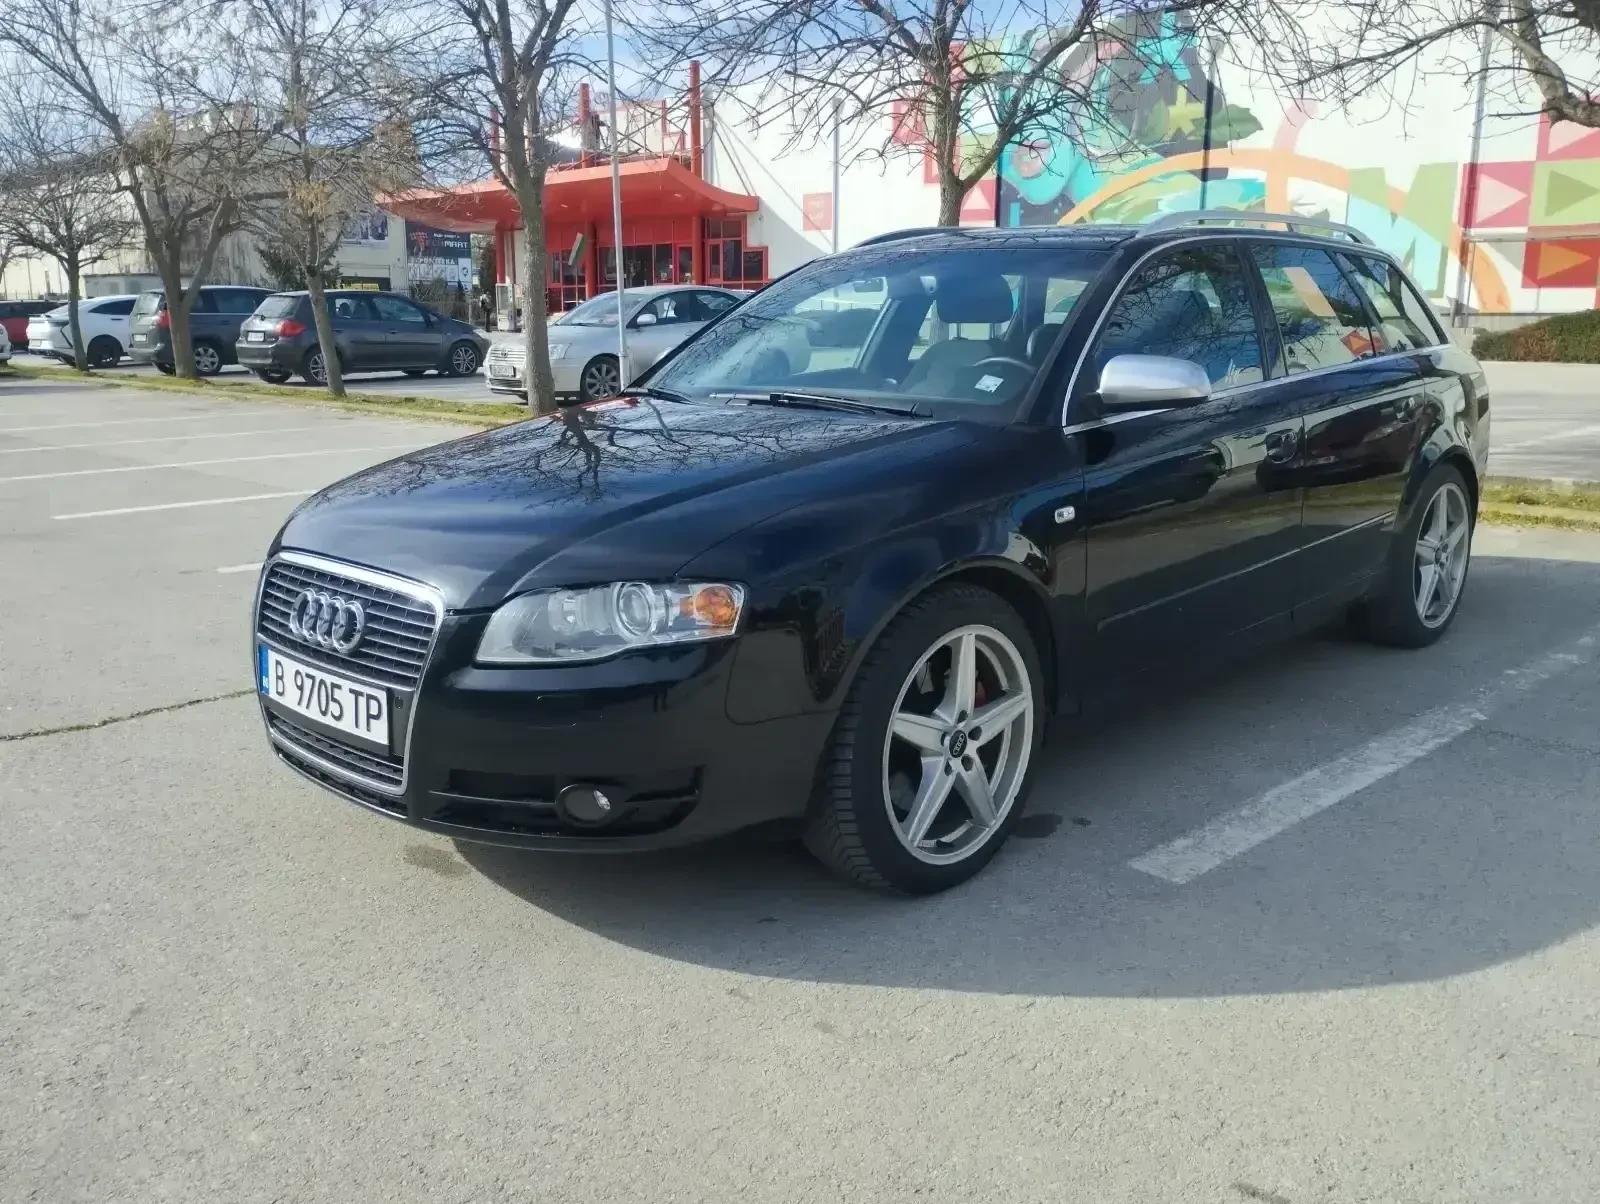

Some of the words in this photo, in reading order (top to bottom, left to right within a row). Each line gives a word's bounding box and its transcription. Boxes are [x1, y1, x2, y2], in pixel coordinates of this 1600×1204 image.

[275, 659, 285, 697] B
[294, 669, 344, 722] 9705
[348, 687, 383, 733] TP
